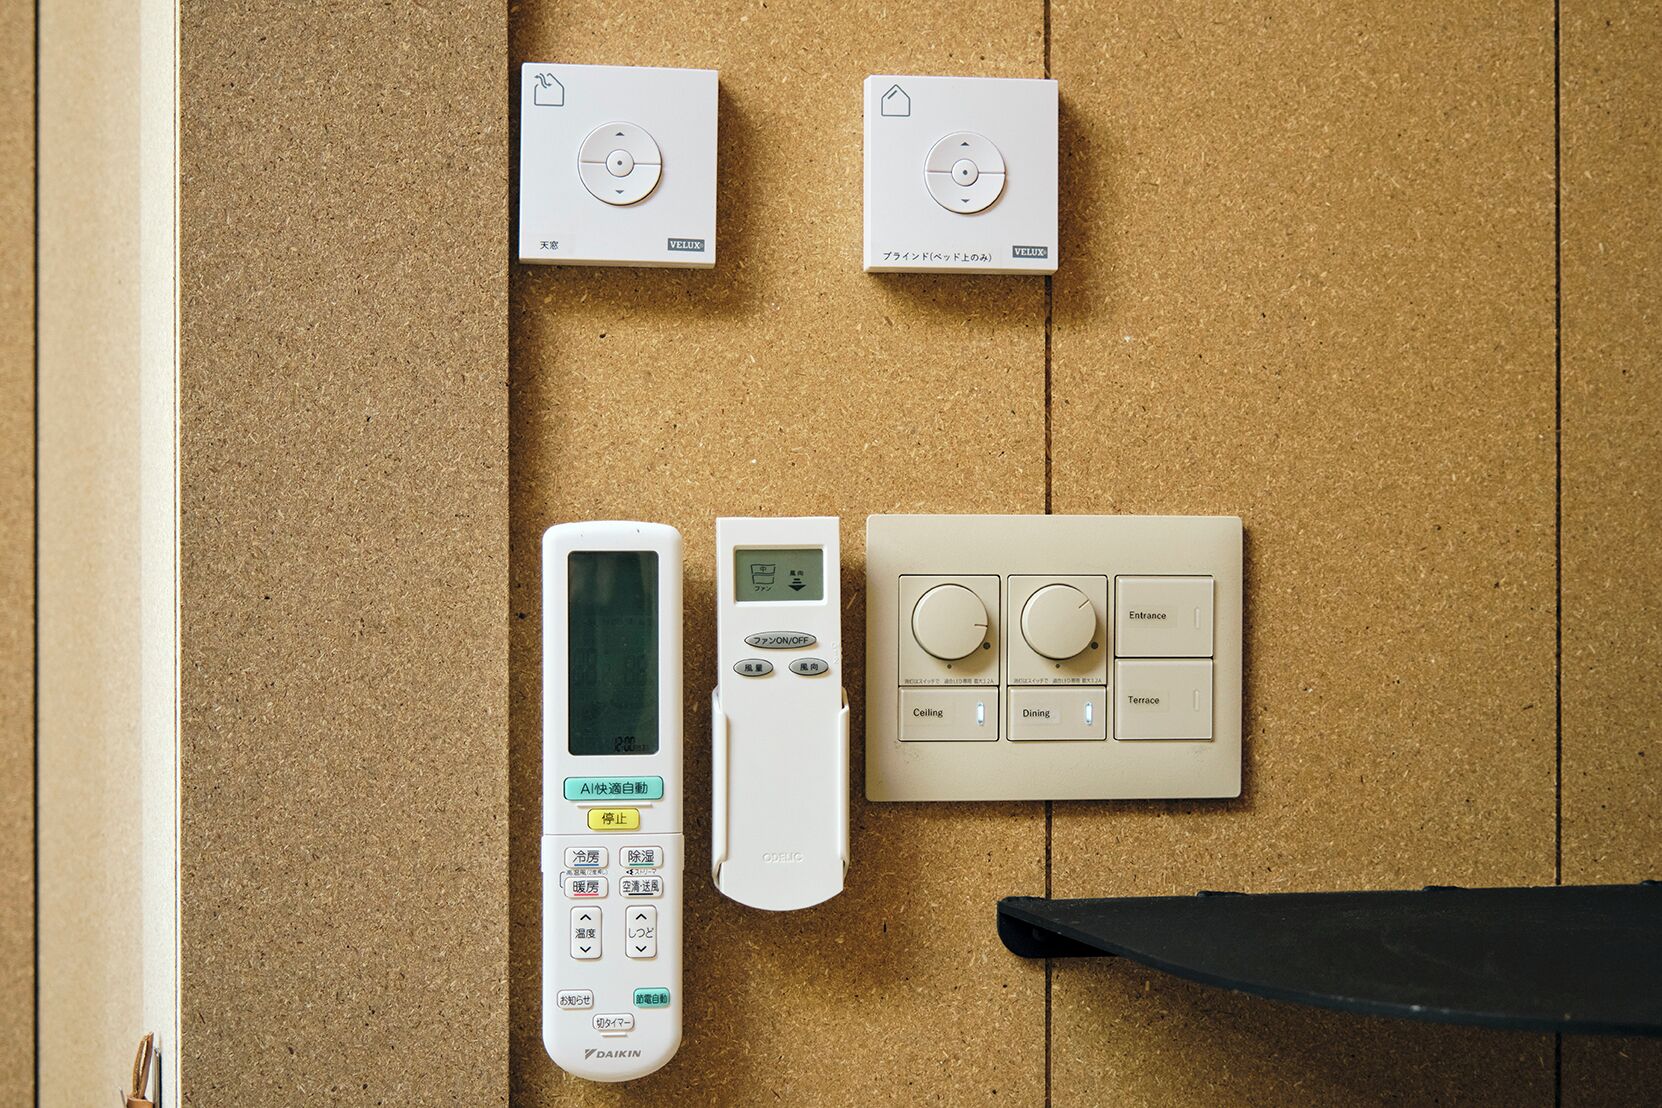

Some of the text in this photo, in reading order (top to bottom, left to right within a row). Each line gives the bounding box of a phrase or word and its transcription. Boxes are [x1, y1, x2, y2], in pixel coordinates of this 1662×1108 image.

[540, 240, 559, 250] 天窓
[1129, 610, 1167, 620] Entrance
[753, 636, 809, 646] ファンON/OFF
[744, 663, 763, 672] 風量
[799, 662, 819, 671] 風向
[1128, 695, 1160, 705] Terrace
[913, 707, 943, 718] Ceiling
[1022, 708, 1050, 718] Dining
[580, 781, 648, 795] AI快適自動
[601, 812, 627, 825] 停止
[573, 849, 599, 863] 冷房
[628, 849, 655, 863] 除湿
[572, 880, 599, 893] 暖房
[575, 928, 596, 939] 温度
[628, 927, 654, 939] しつど
[560, 995, 591, 1006] お知らせ
[635, 993, 668, 1005] 節電自動
[596, 1018, 631, 1029] 切タイマー
[596, 1050, 642, 1059] DAIKIN
